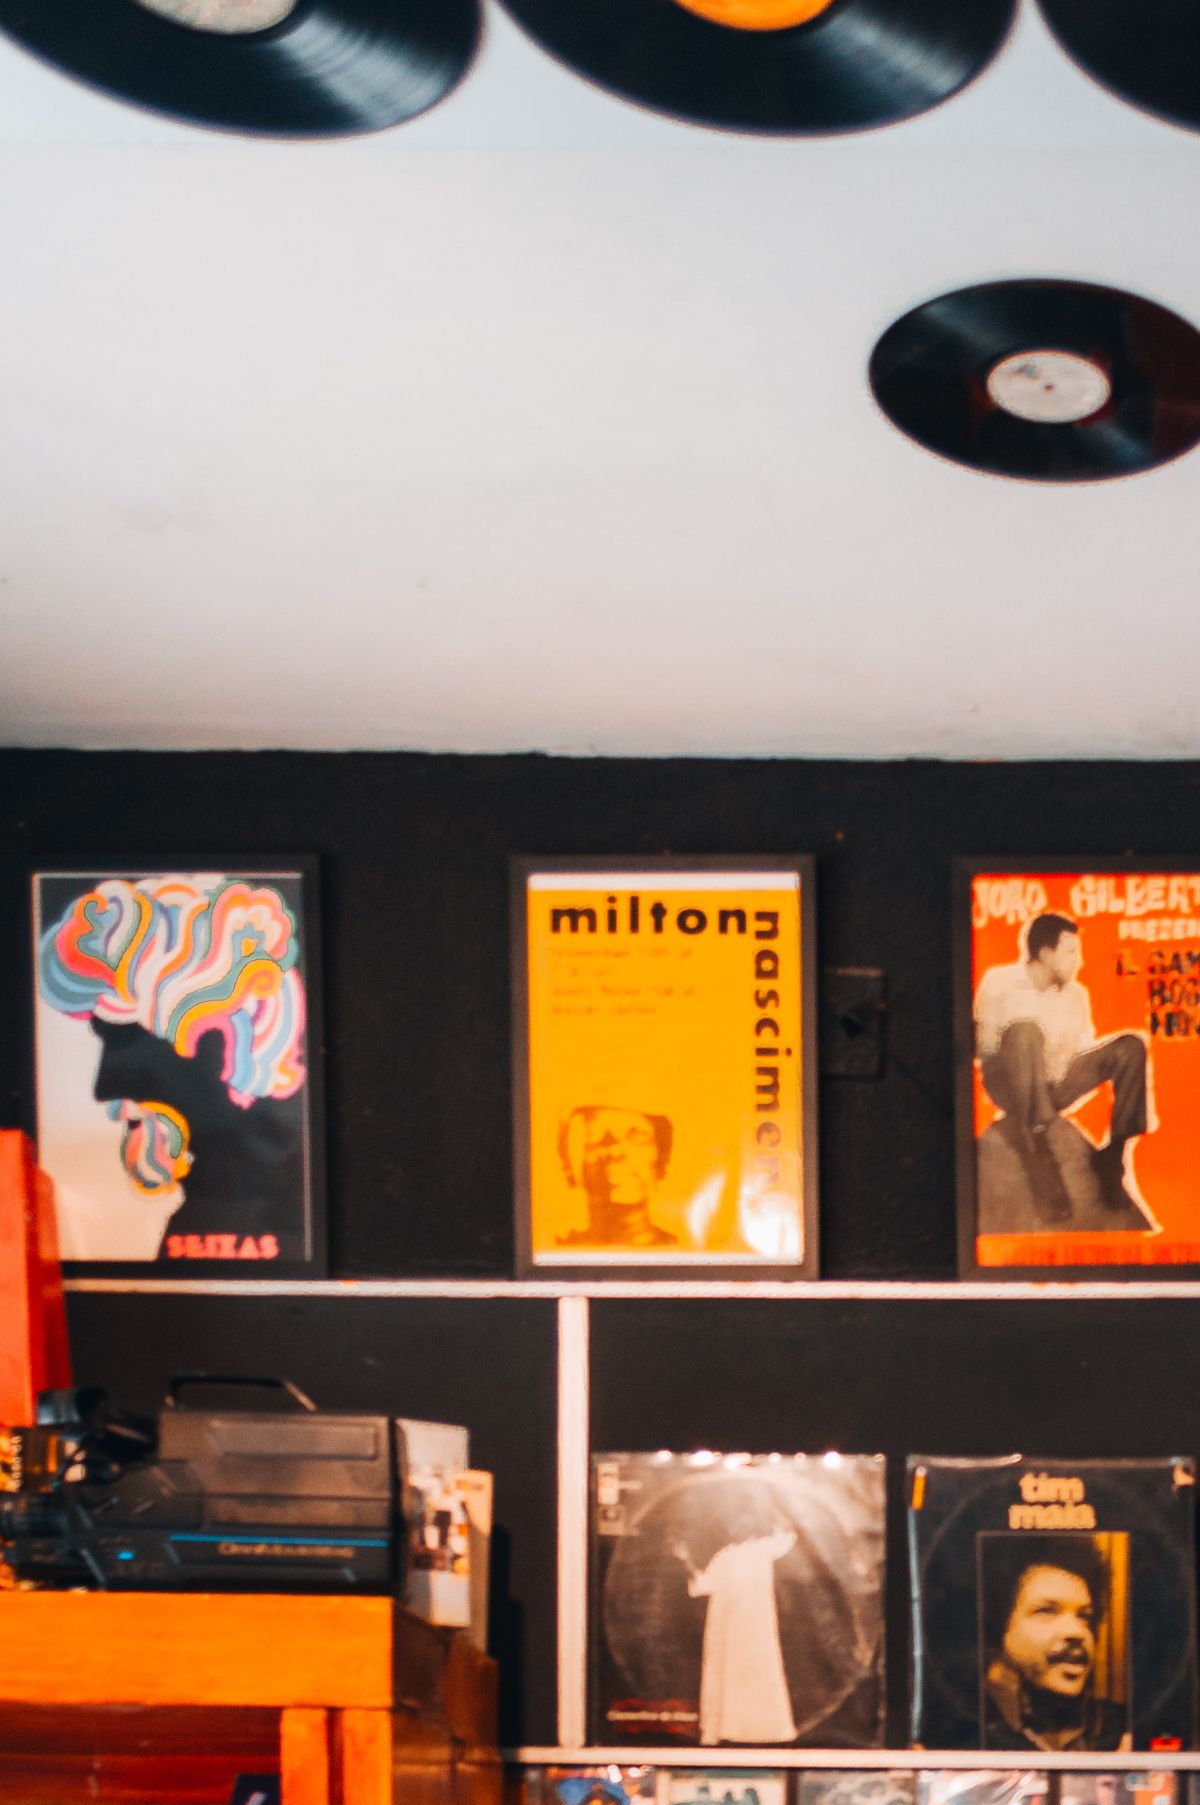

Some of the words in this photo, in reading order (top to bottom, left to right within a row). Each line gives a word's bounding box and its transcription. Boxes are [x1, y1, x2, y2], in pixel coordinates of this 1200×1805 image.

[550, 894, 747, 935] milton
[753, 910, 792, 1186] nascimen
[166, 1233, 279, 1259] SEIXAS
[1018, 1472, 1085, 1503] tim
[1008, 1502, 1097, 1531] maia
